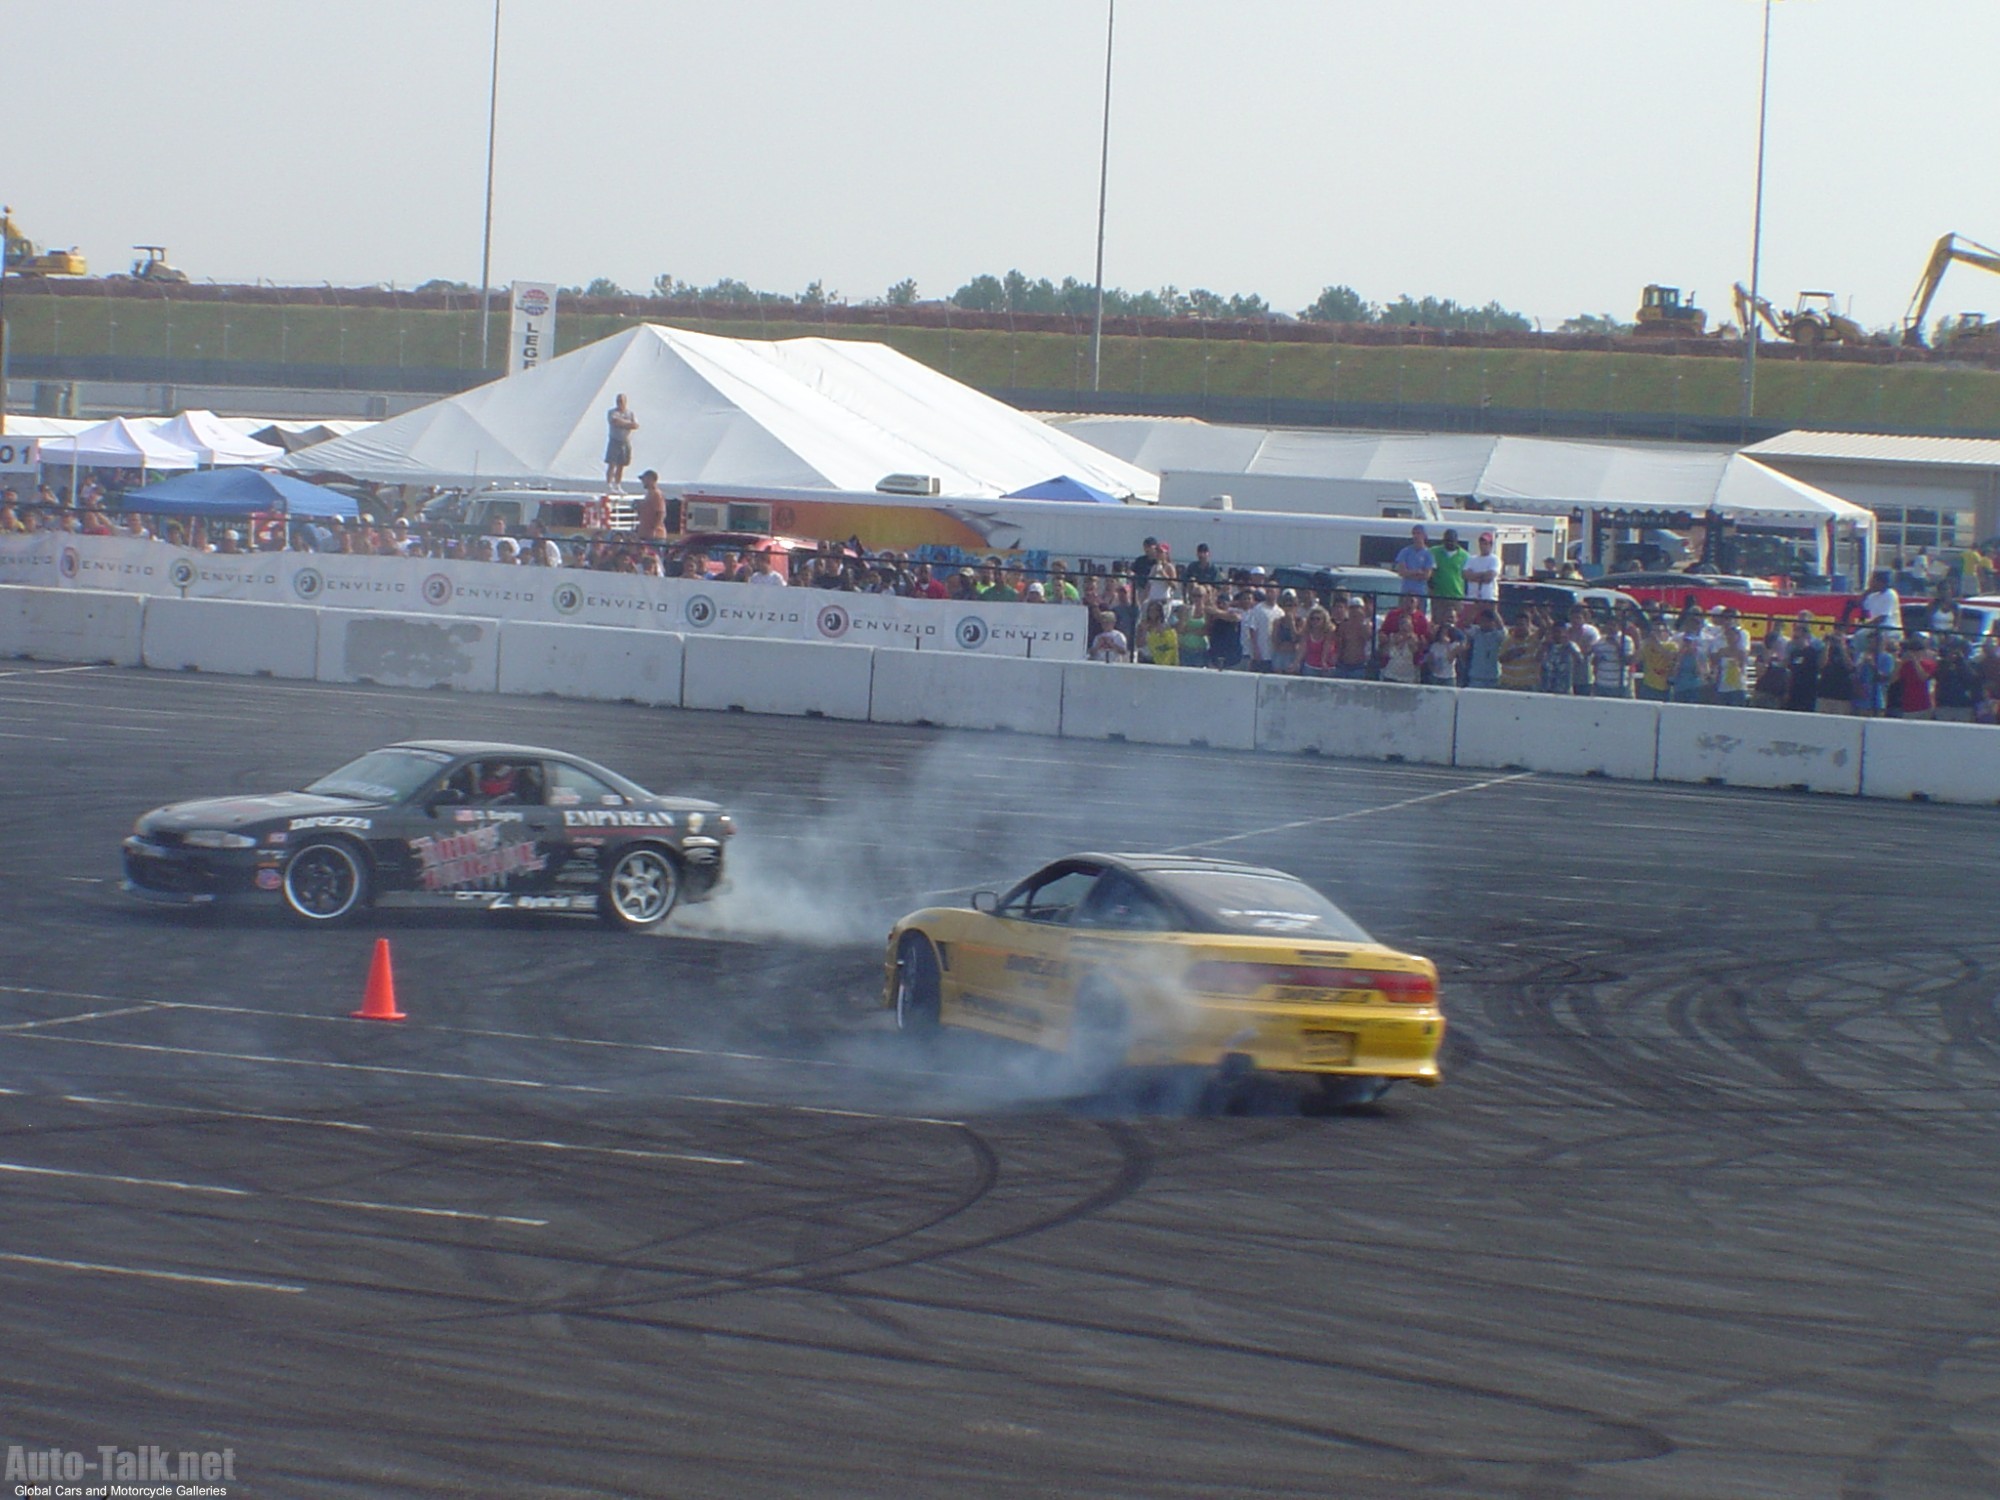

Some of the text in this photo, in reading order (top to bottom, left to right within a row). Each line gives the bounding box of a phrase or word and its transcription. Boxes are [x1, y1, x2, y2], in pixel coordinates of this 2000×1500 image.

[82, 562, 154, 576] ENVIZIO
[201, 571, 276, 584] ENVIZIO
[327, 580, 406, 593] ENVIZIO
[456, 586, 534, 602] ENVIZIO
[587, 596, 668, 613] ENVIZIO
[719, 608, 799, 623] ENVIZIO
[853, 618, 936, 636] ENVIZIO
[991, 629, 1075, 642] ENVIZIO
[563, 810, 675, 826] EMPYREAN
